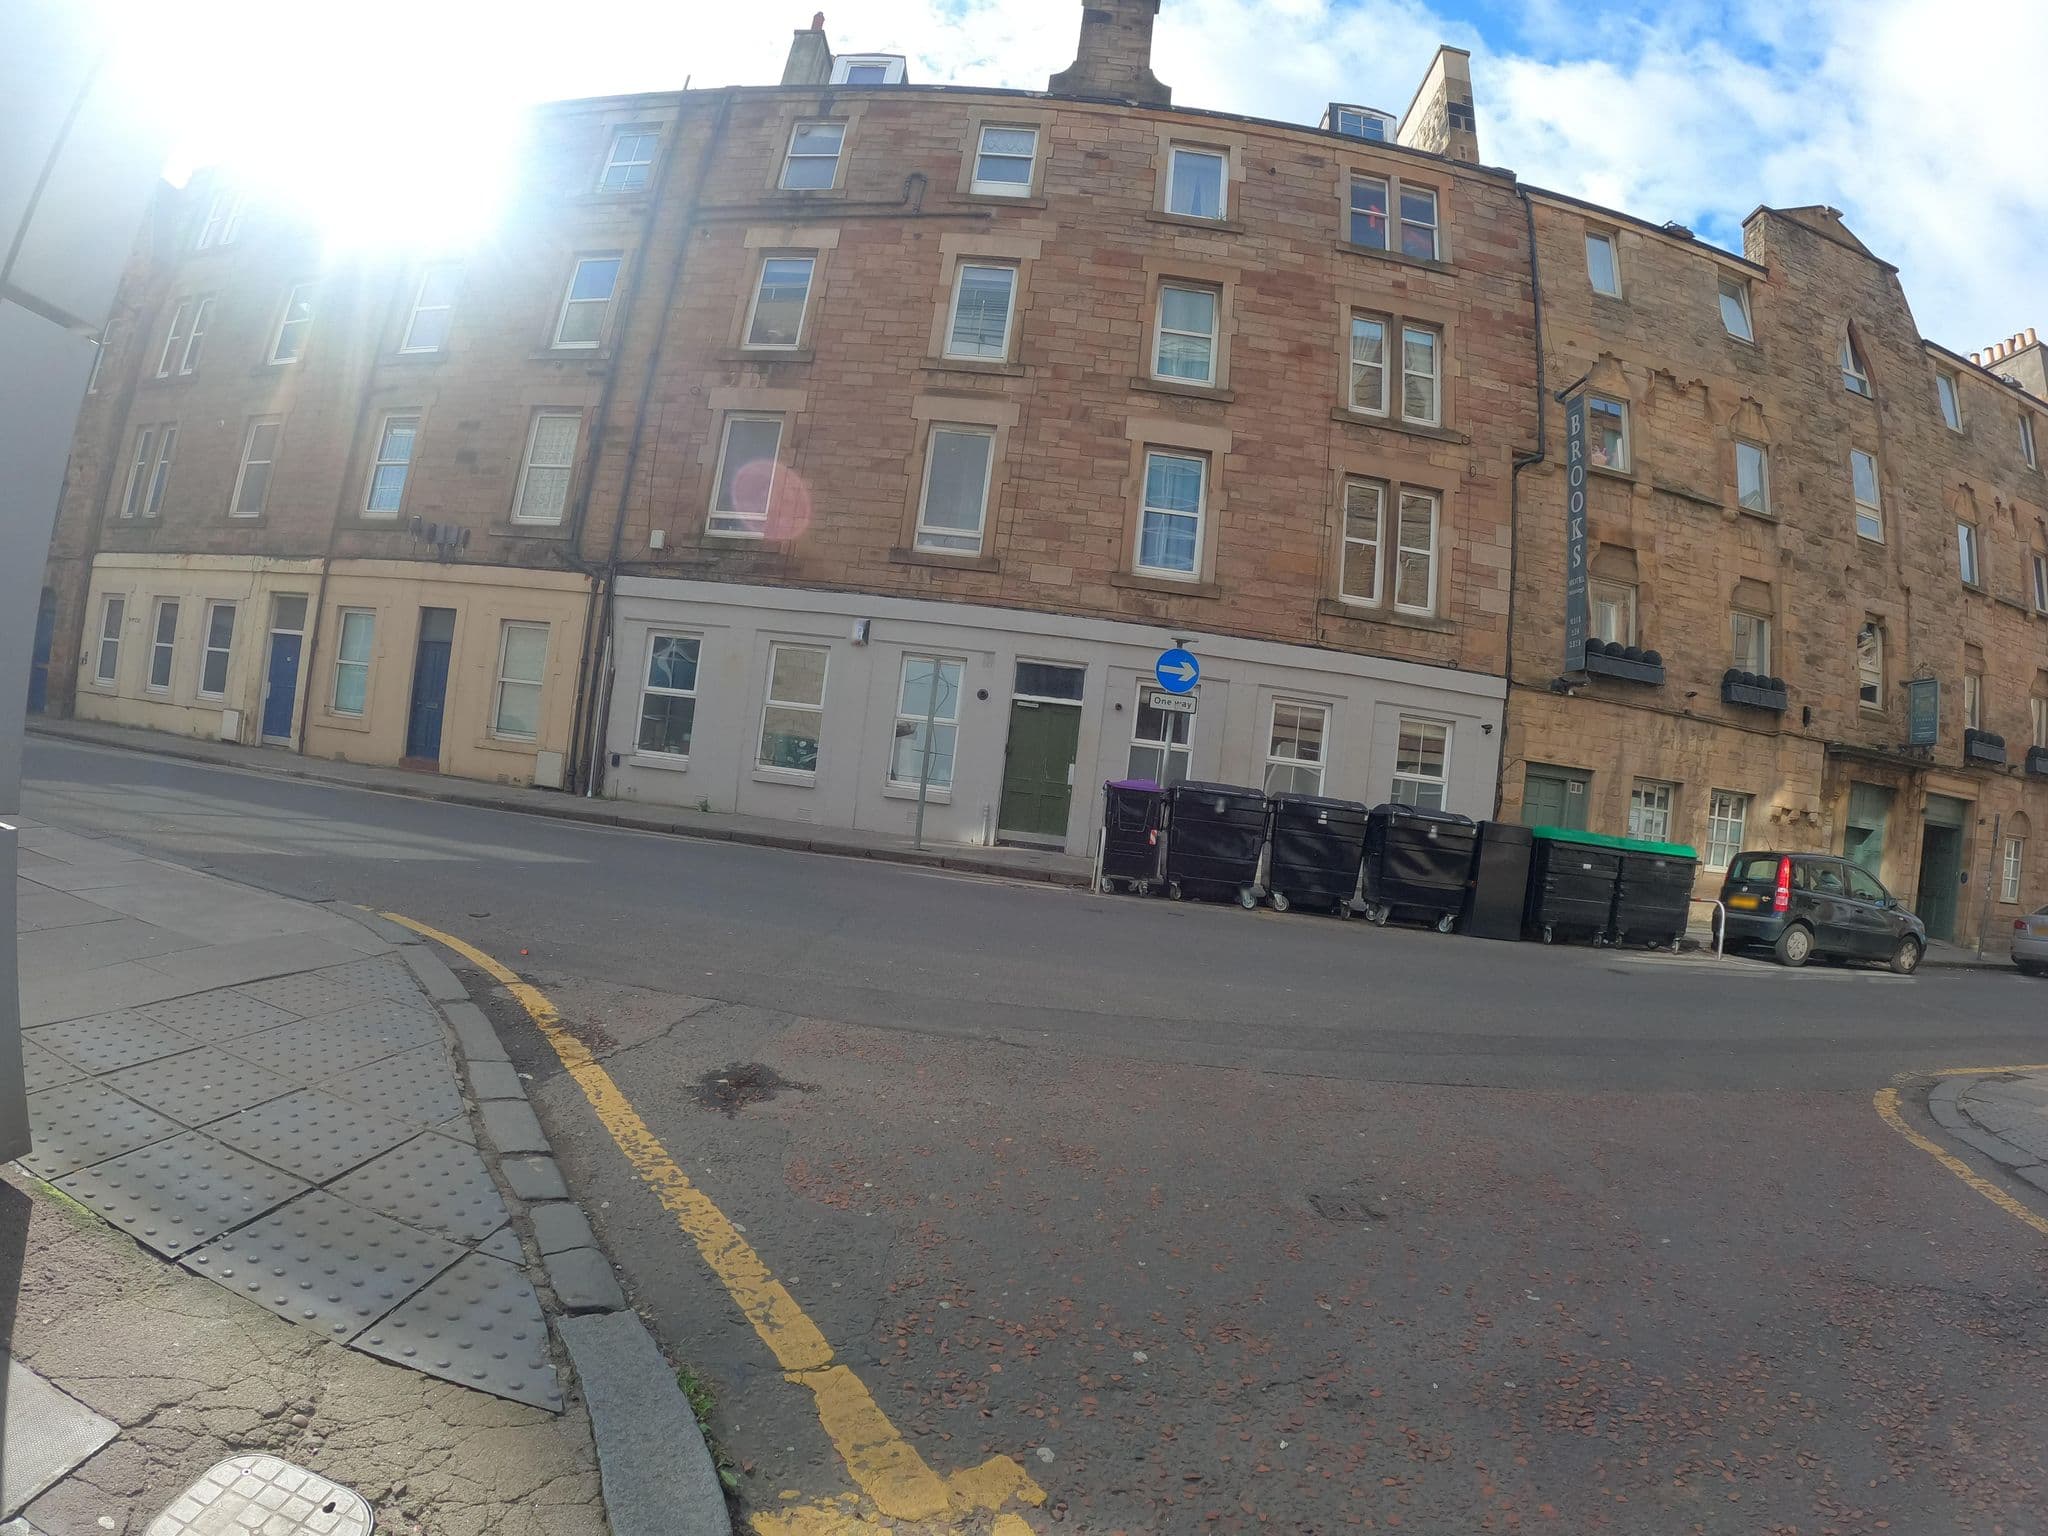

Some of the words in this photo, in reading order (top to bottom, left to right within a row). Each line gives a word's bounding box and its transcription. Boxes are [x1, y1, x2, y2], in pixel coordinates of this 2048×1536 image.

[1570, 414, 1583, 568] BROOKS
[1154, 696, 1172, 705] One
[1174, 700, 1192, 709] way
